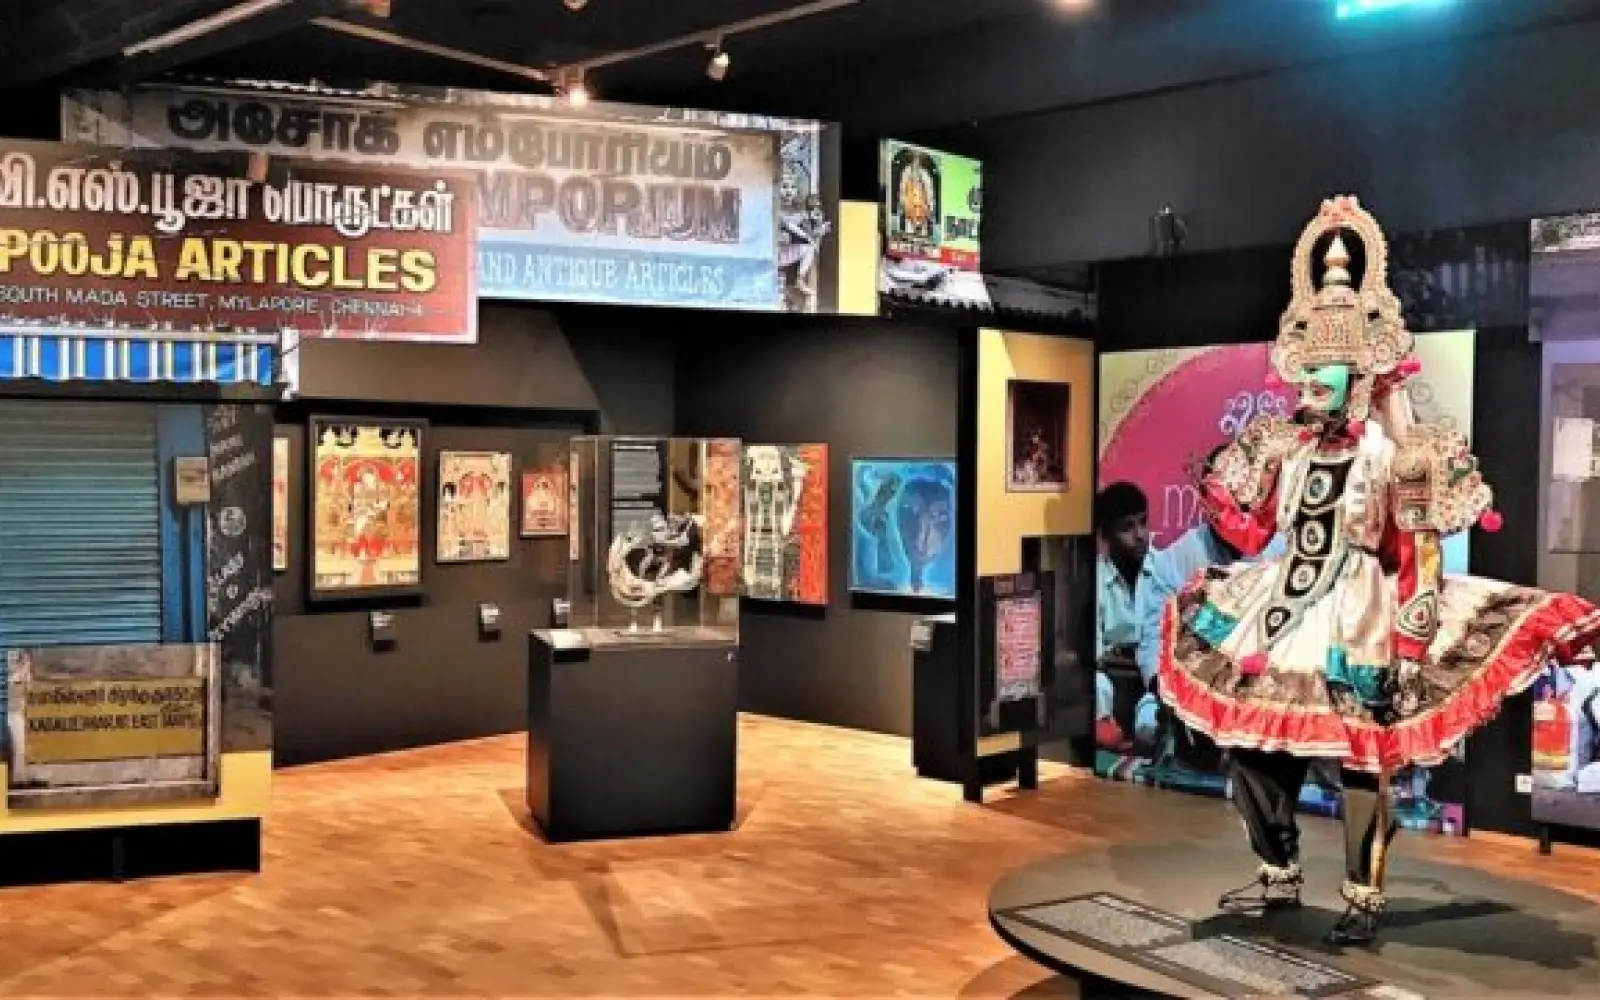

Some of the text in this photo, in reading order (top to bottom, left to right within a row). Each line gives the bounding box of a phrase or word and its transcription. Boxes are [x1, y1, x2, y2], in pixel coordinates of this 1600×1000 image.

[476, 170, 741, 244] MPORIUM
[175, 237, 436, 292] ARTICLES
[523, 254, 617, 289] ANTIQUE
[625, 259, 724, 295] ARTICLES
